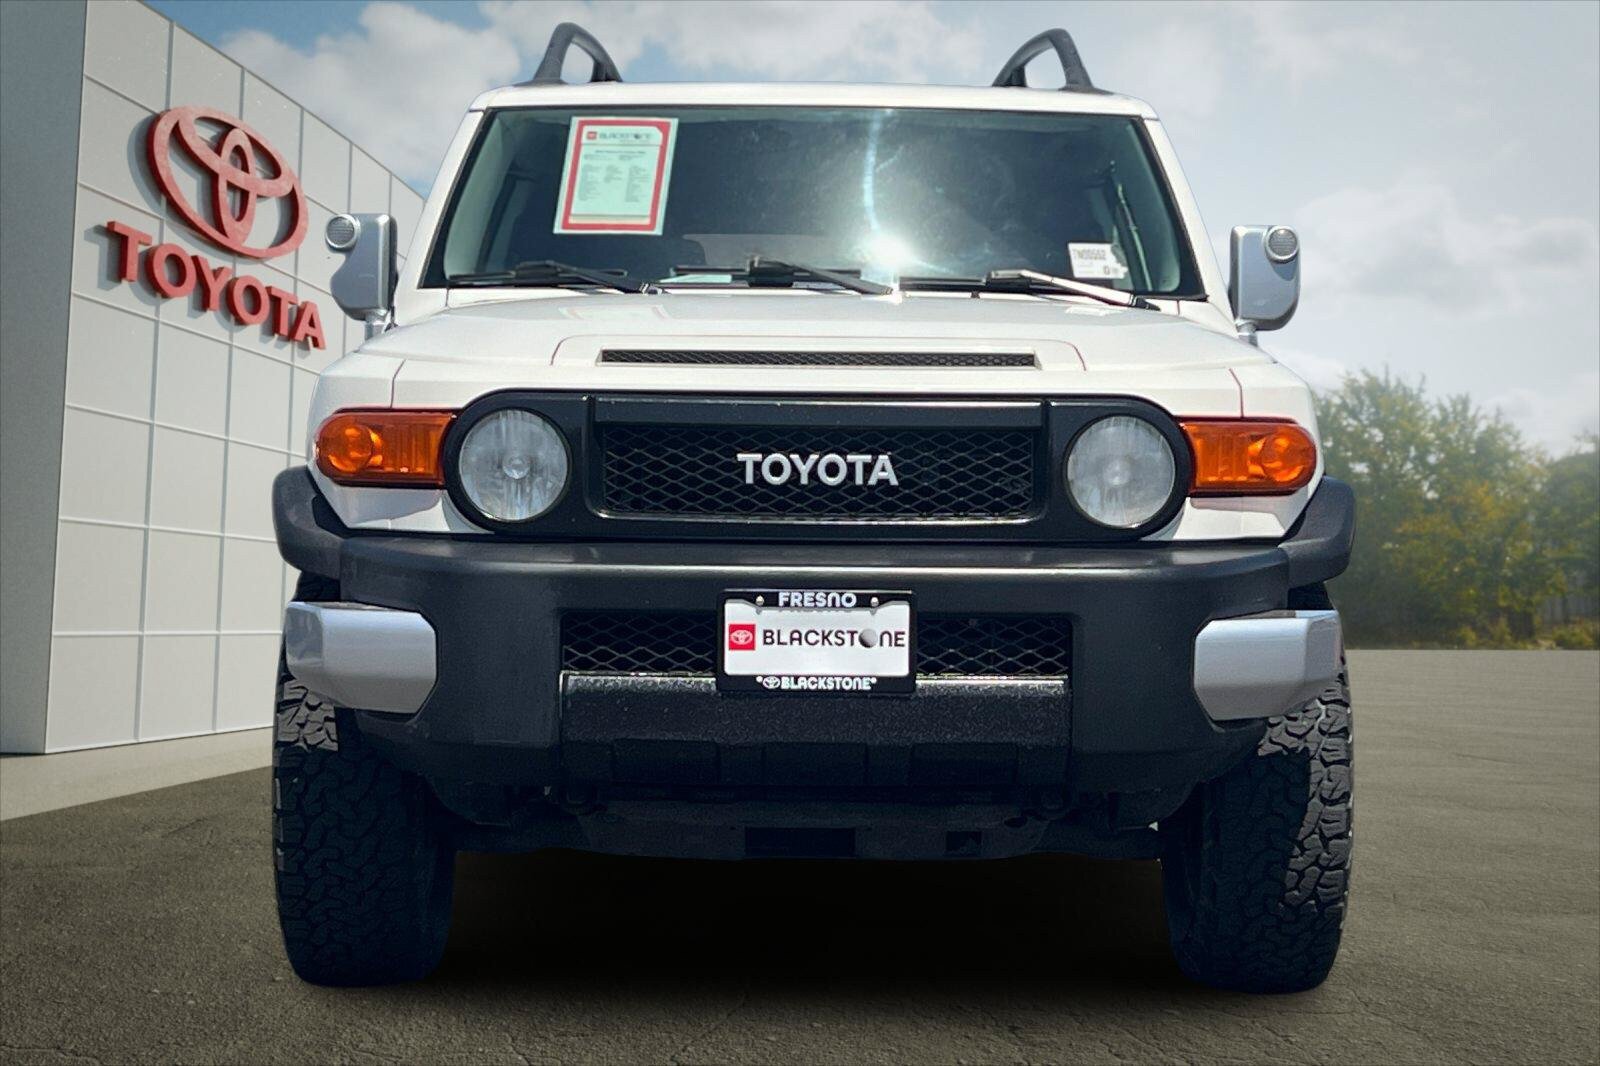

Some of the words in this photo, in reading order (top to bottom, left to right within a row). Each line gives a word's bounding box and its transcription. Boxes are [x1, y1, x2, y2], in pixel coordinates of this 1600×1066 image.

[107, 221, 325, 350] TOYOTA
[736, 453, 899, 486] TOYOTA
[778, 592, 857, 608] FRESNO
[762, 628, 906, 648] BLACKSTONE
[781, 676, 871, 690] BLACKSTONE
